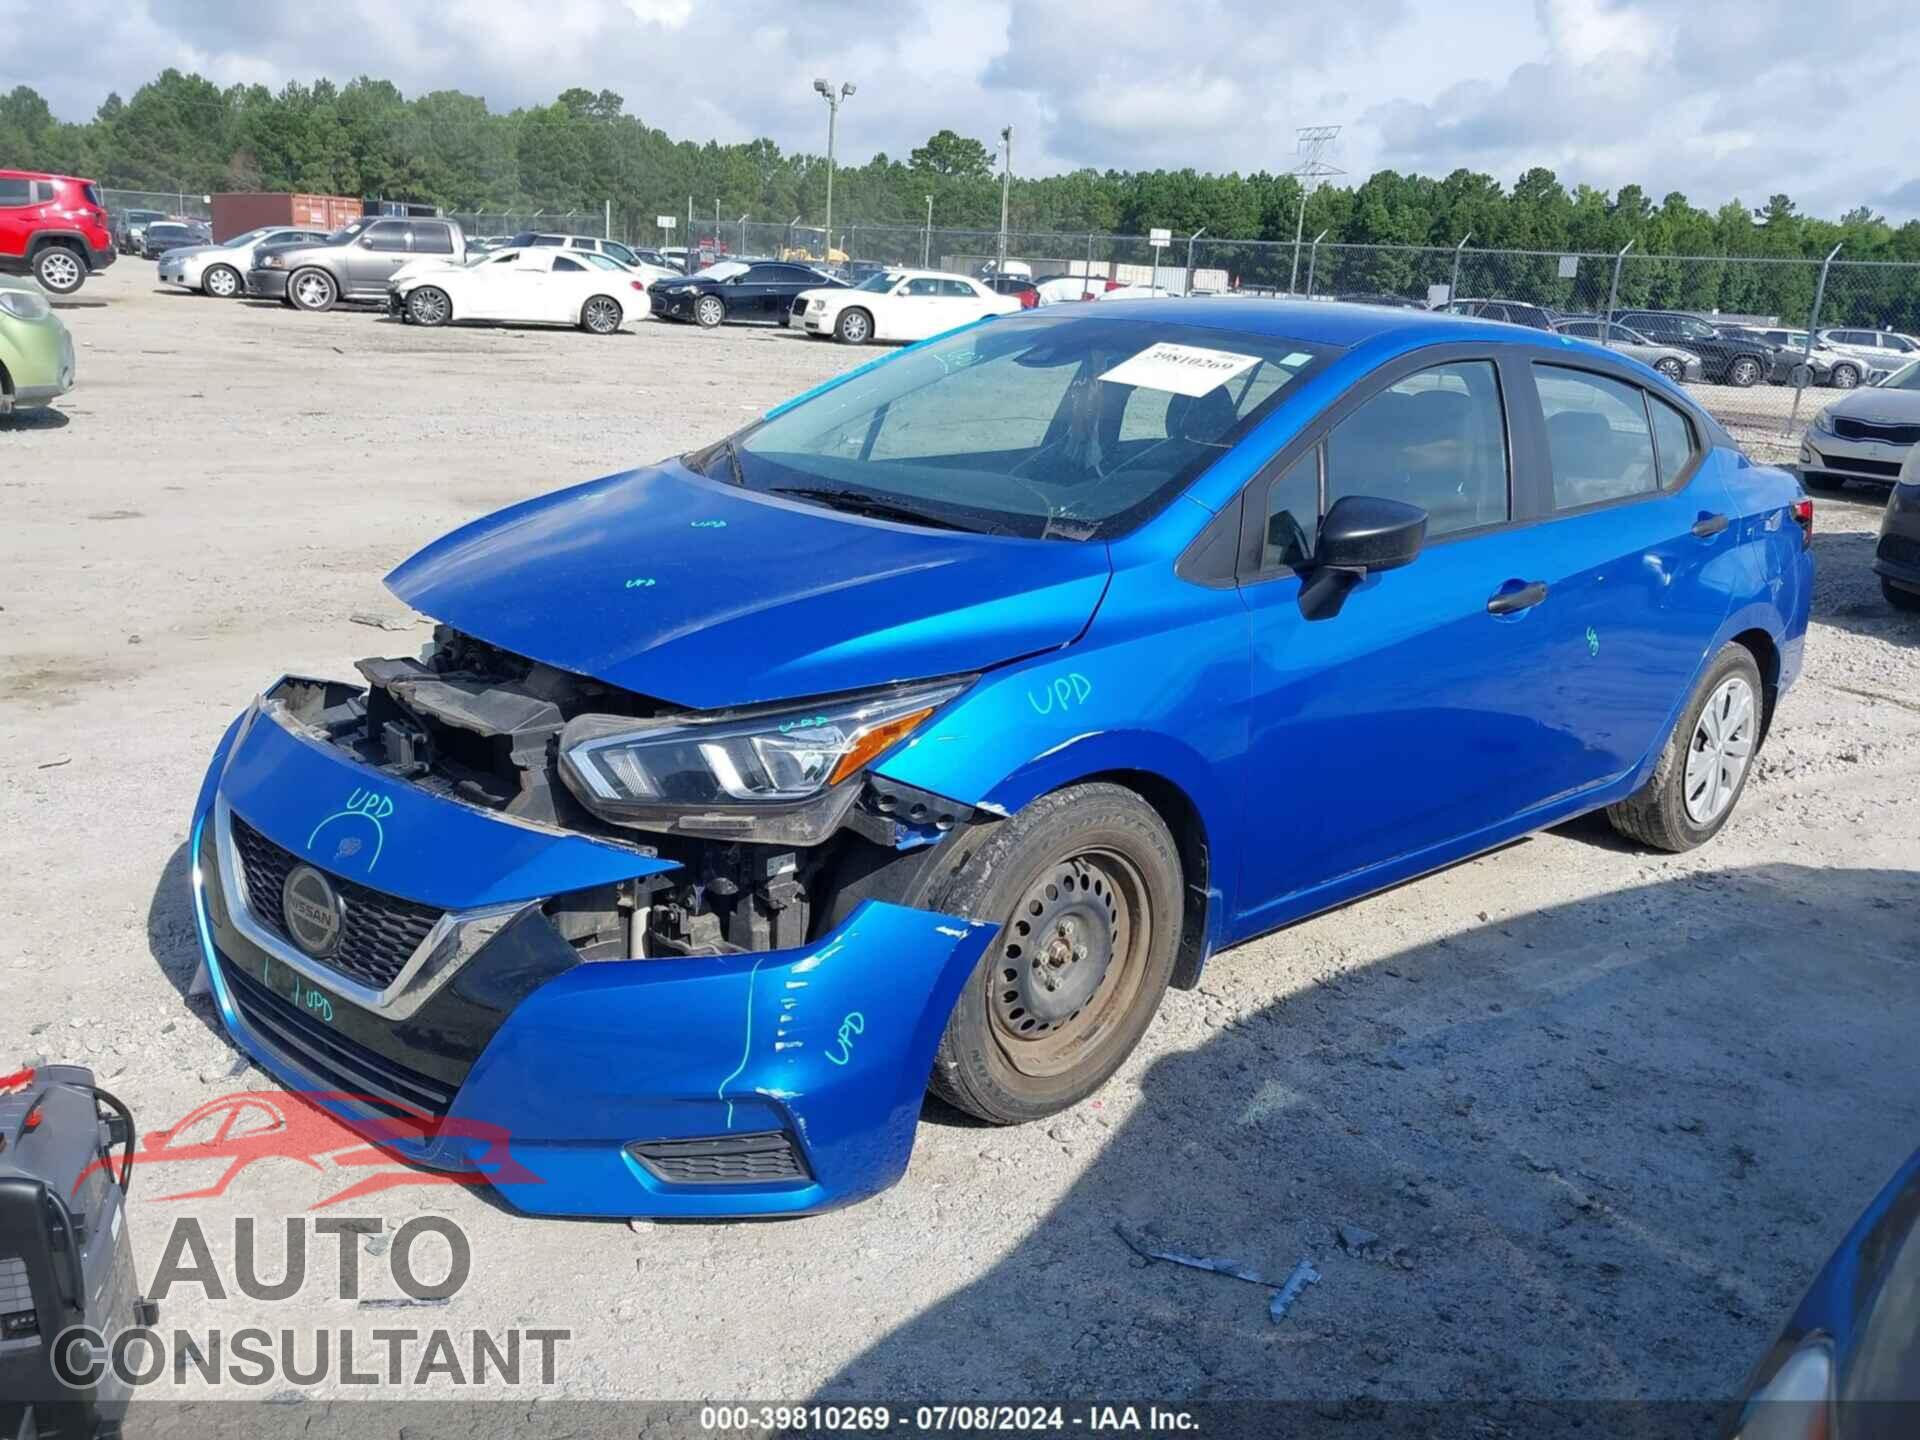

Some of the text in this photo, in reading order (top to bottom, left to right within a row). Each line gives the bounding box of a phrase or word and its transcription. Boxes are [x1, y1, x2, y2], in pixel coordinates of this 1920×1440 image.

[1028, 673, 1092, 715] UPD
[346, 787, 394, 818] UPD
[306, 991, 333, 1022] UPD
[824, 1012, 865, 1066] UPD
